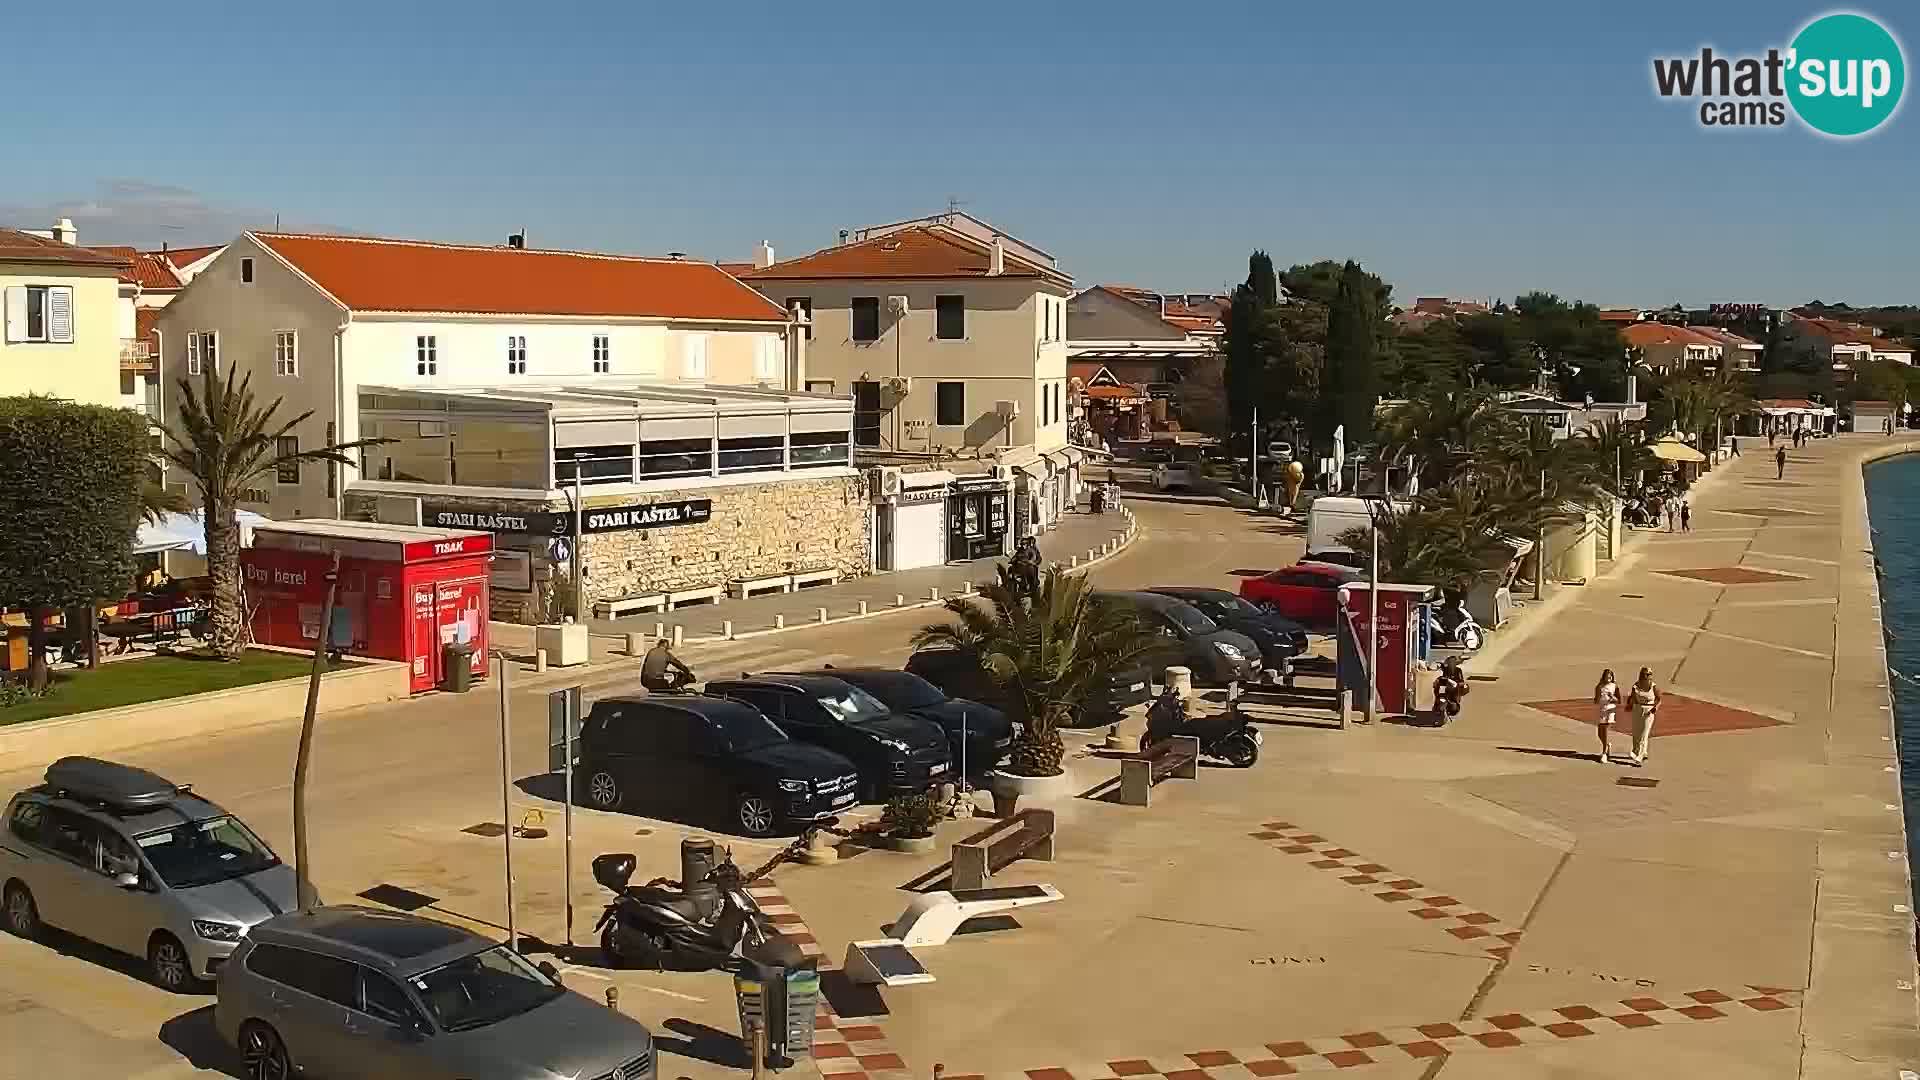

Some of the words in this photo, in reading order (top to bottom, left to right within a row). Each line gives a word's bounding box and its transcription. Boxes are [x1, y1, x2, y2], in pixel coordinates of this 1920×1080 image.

[437, 512, 475, 527] STARI
[477, 513, 528, 531] KAŠTEL
[589, 511, 628, 529] STARI
[631, 506, 681, 525] KAŠTEL
[434, 541, 464, 554] TISAK
[247, 564, 268, 585] Buy
[274, 568, 307, 585] here!
[415, 592, 434, 605] Buy
[439, 587, 463, 601] here!
